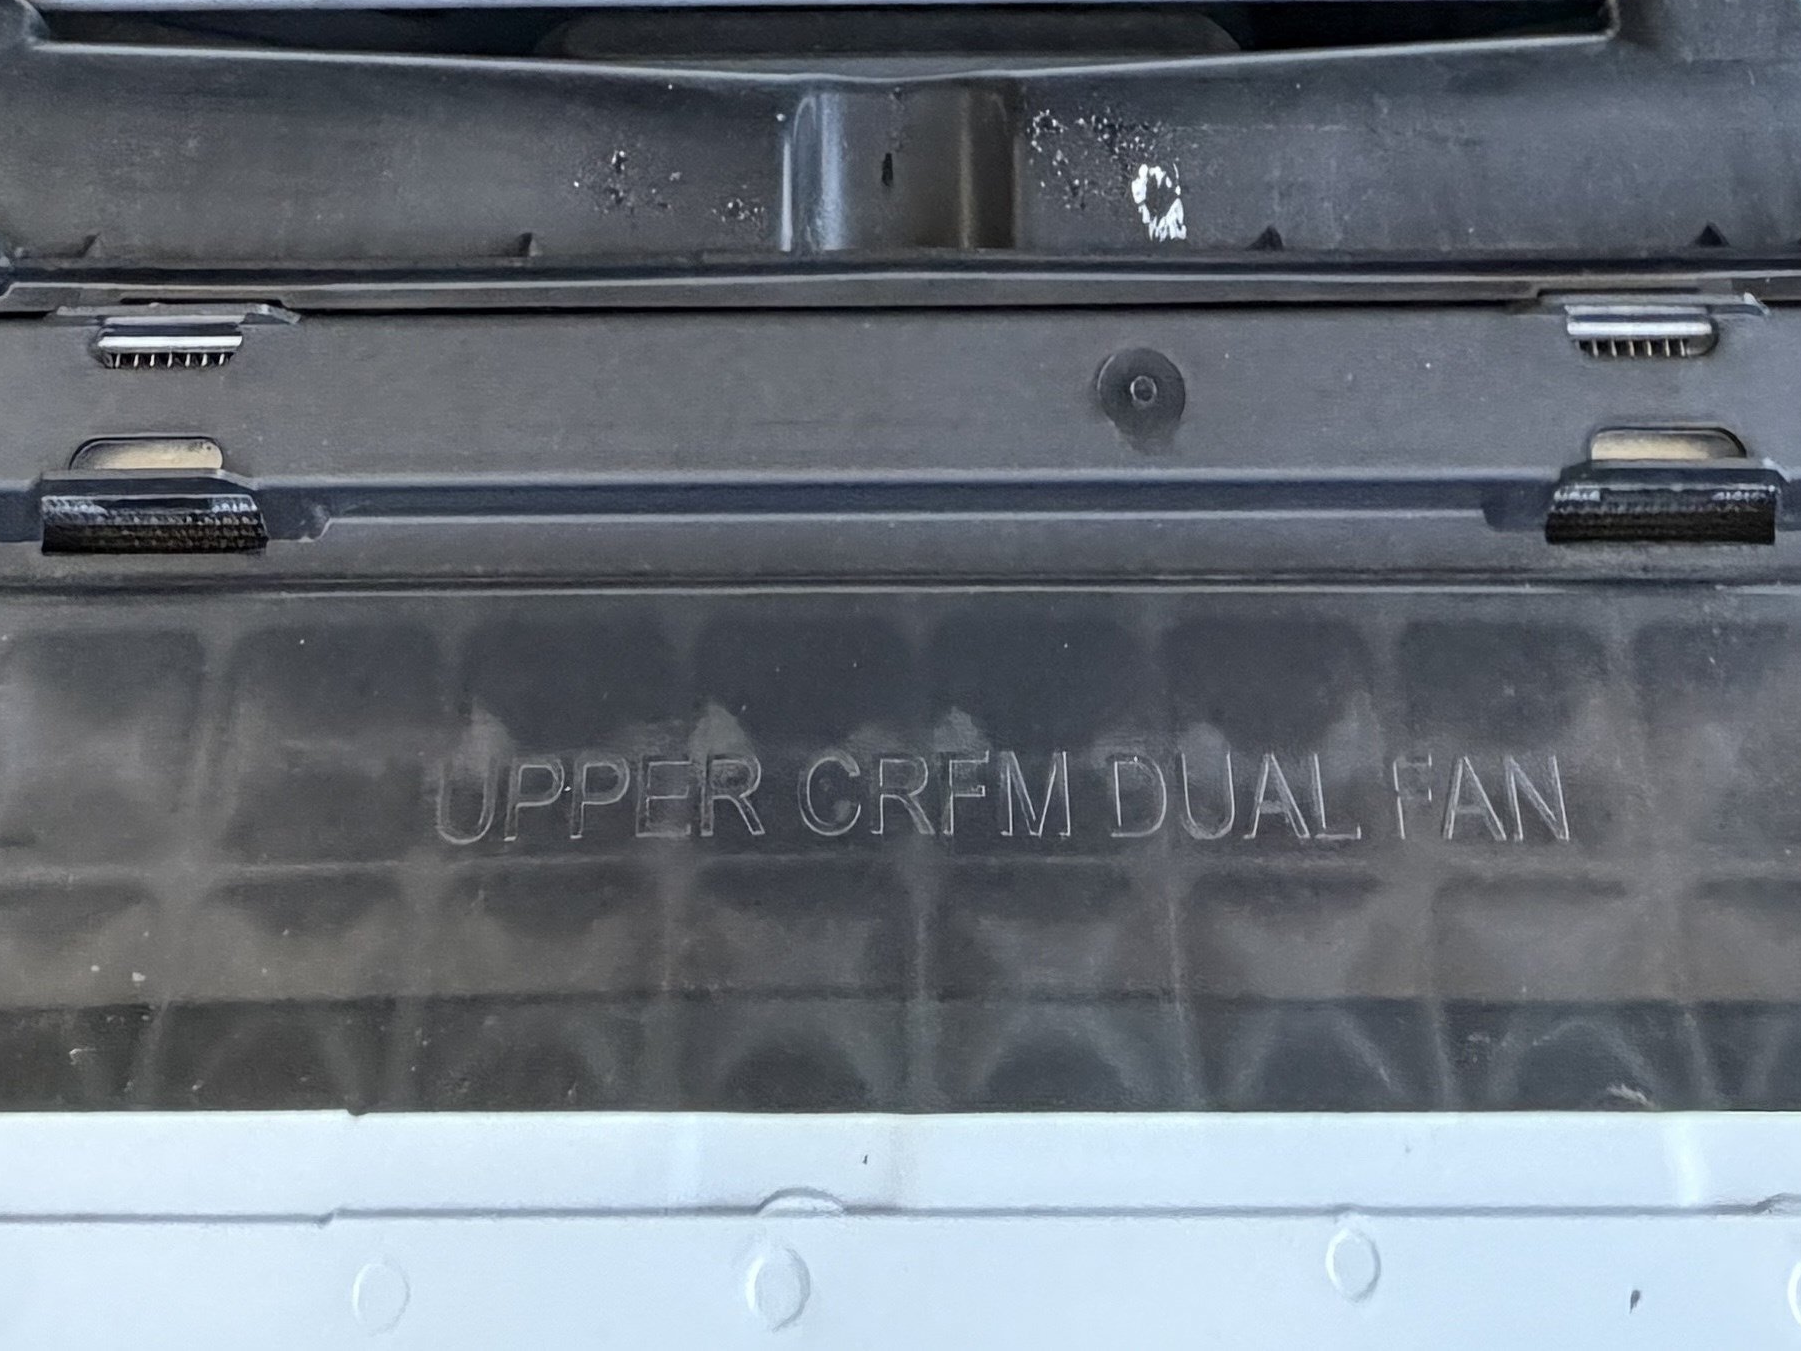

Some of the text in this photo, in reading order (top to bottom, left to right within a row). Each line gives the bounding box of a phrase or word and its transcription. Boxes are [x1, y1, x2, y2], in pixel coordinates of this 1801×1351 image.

[435, 750, 1569, 844] UPPER CRFM DUAL FAN
